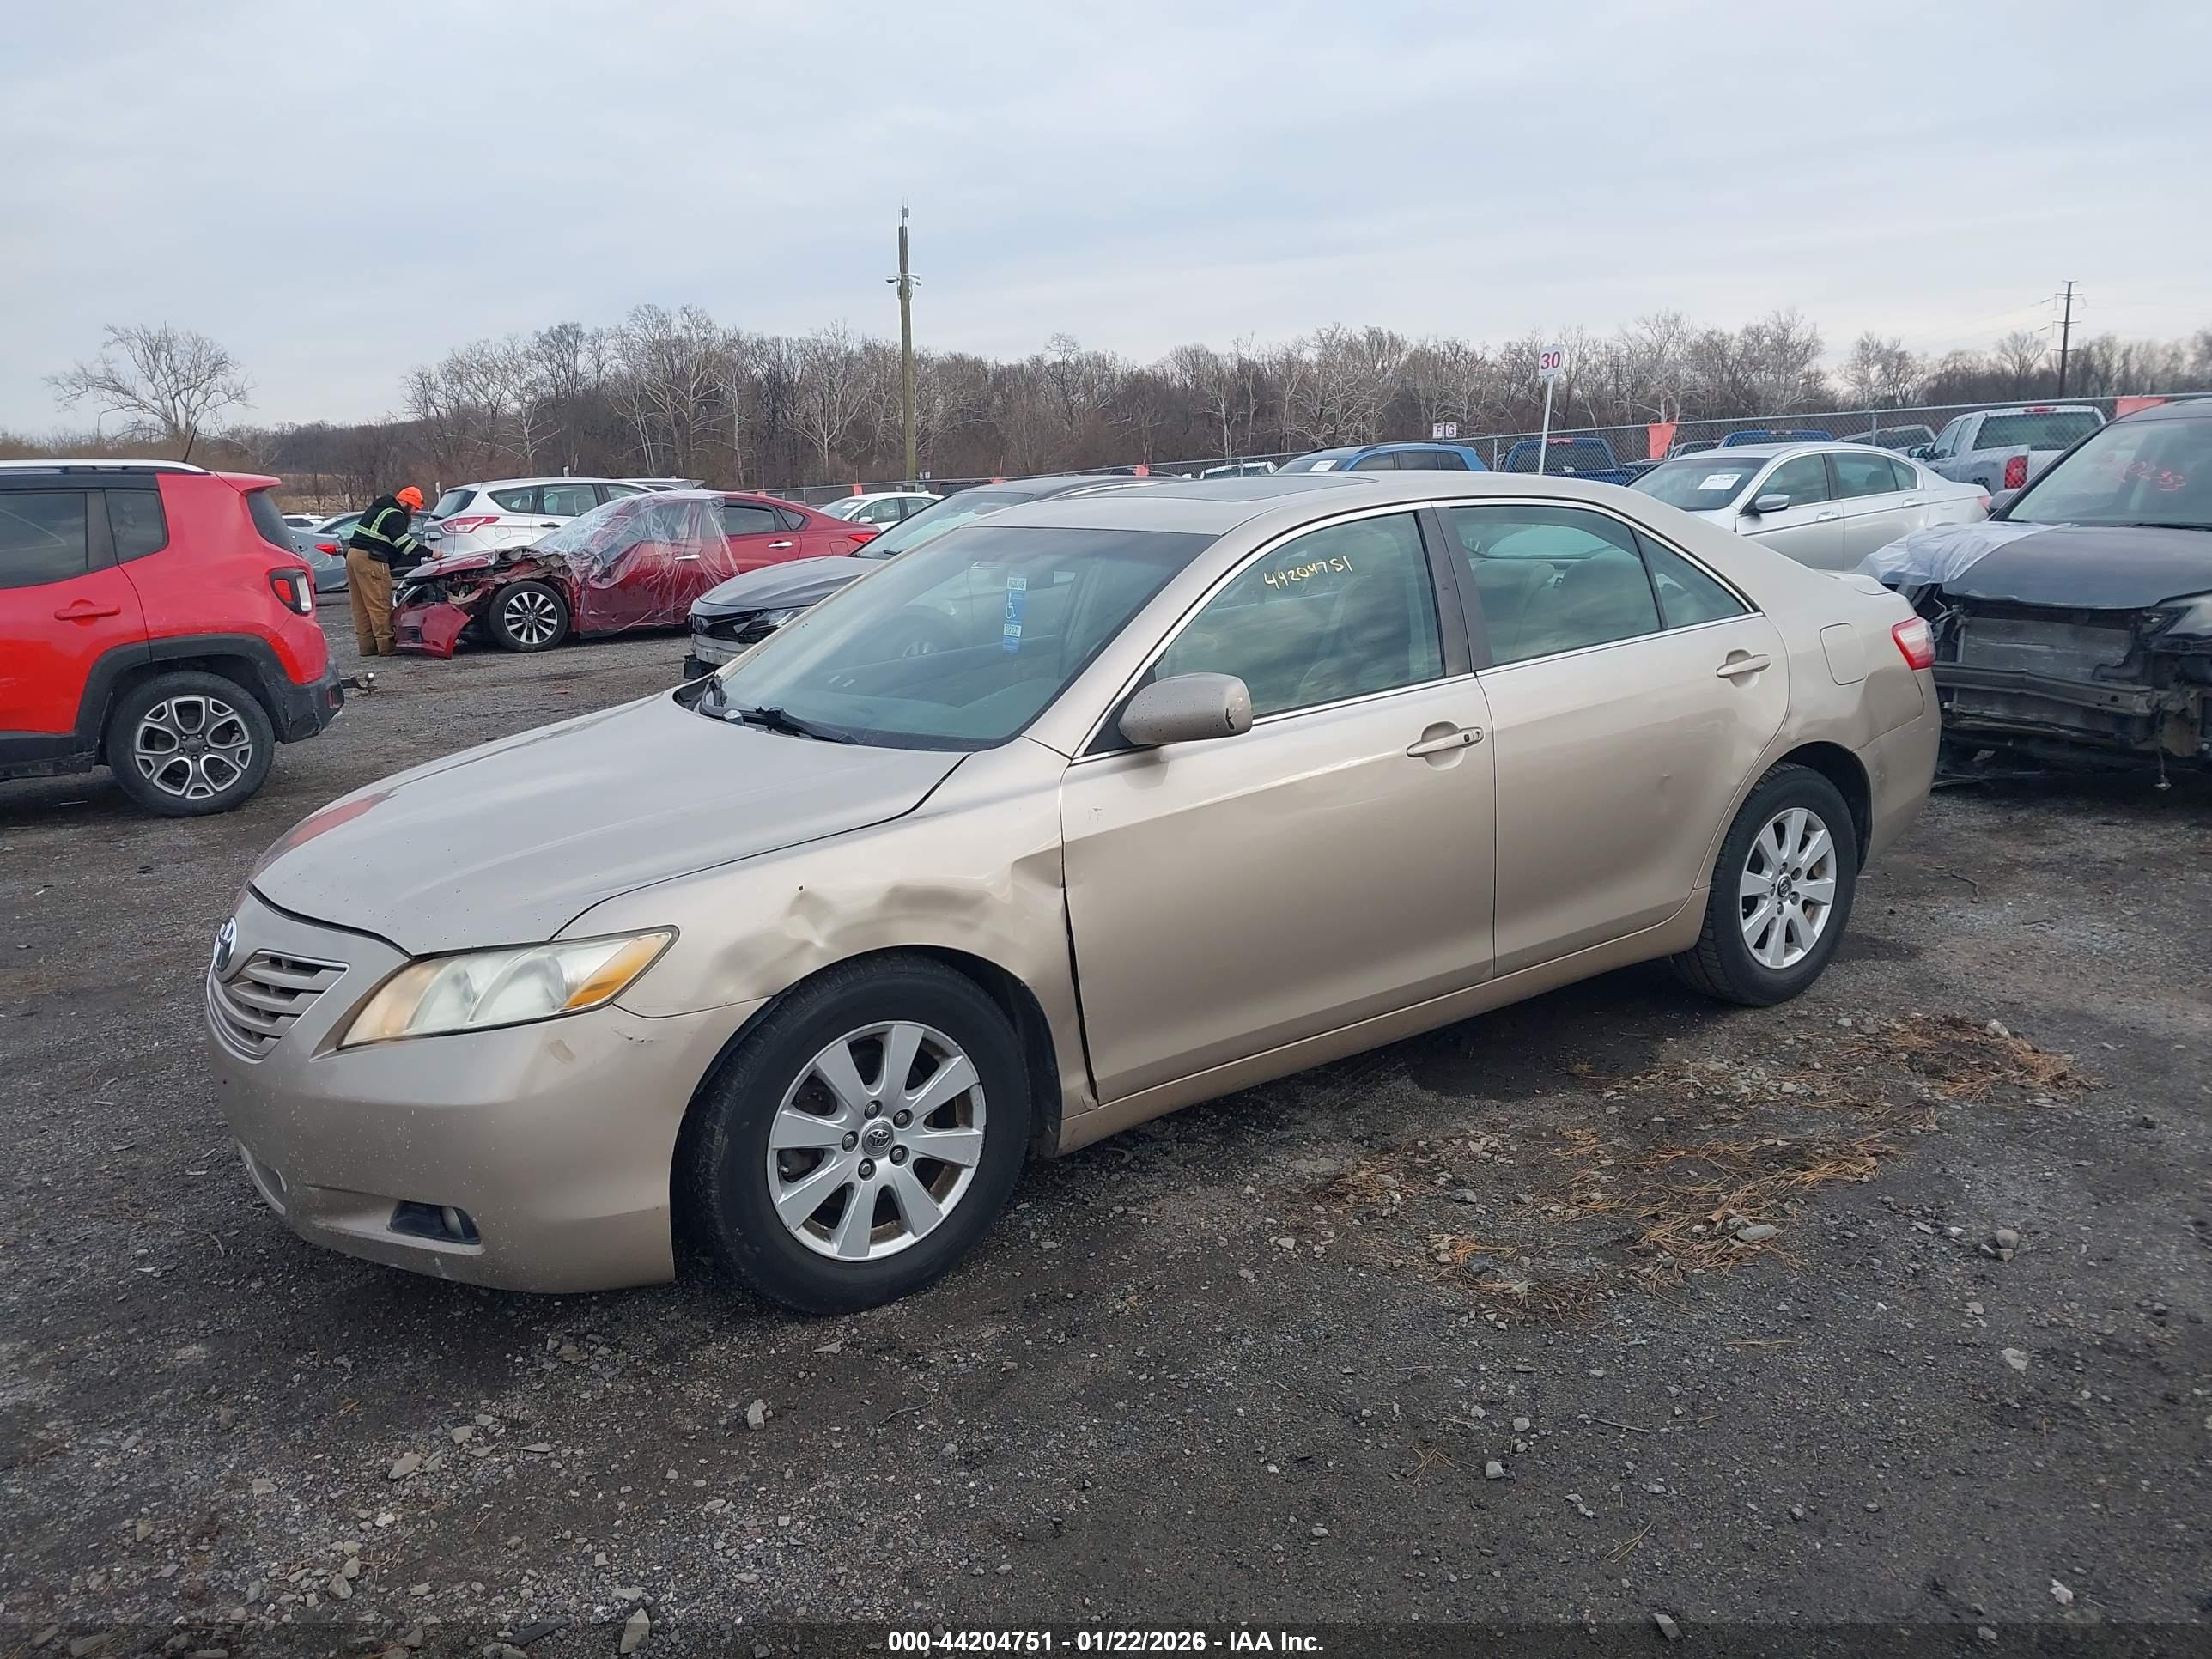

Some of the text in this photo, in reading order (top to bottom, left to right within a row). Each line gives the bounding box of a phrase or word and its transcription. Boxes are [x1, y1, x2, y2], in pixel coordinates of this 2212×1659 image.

[1540, 351, 1561, 370] 30
[1436, 426, 1442, 436] F
[1448, 424, 1455, 435] G
[1263, 556, 1353, 590] 44204751
